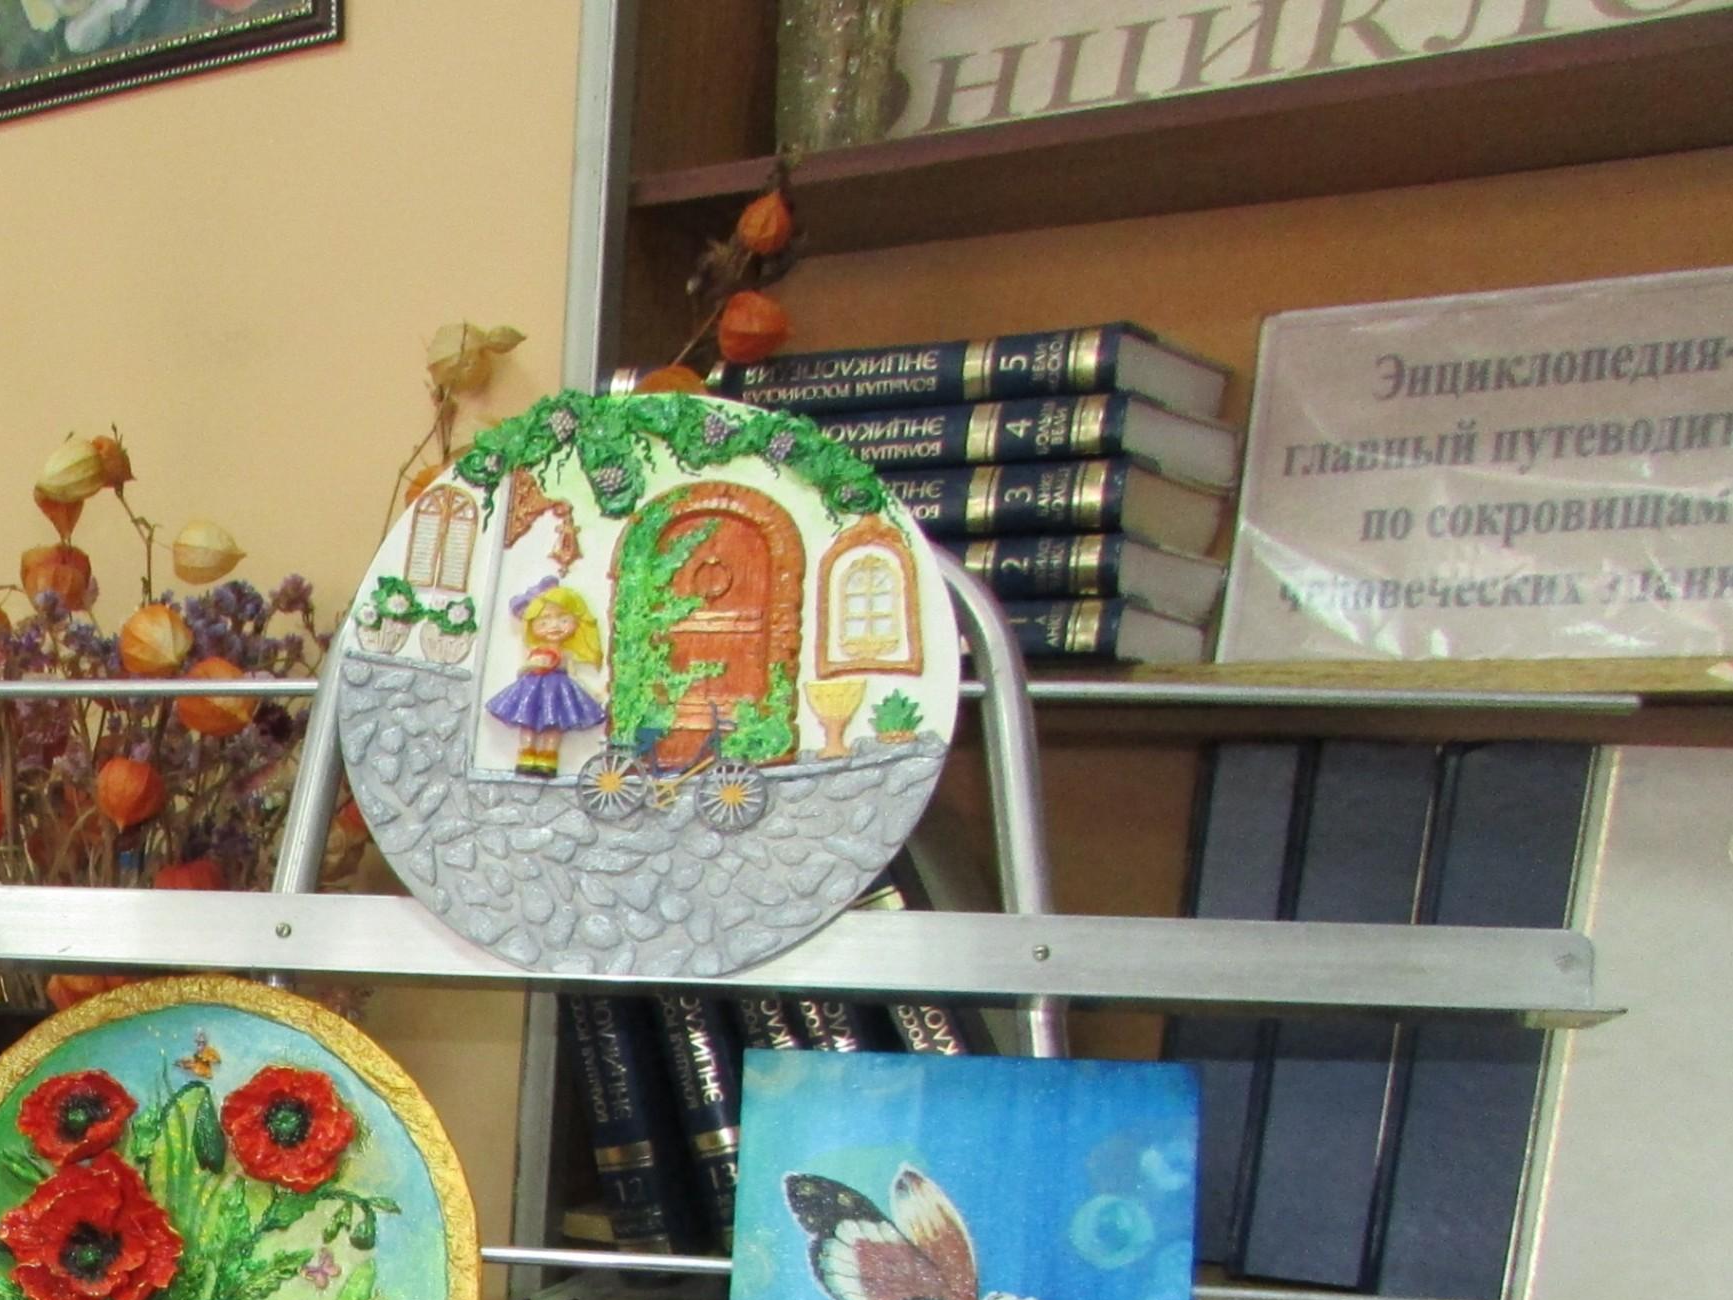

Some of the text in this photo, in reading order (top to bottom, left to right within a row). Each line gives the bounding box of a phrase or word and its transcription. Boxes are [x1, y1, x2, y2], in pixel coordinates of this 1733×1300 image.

[999, 353, 1028, 373] 5
[856, 376, 938, 397] БОЛЬШАЯ
[1004, 417, 1033, 439] 4
[859, 440, 943, 461] БОЛЬШАЯ
[1282, 419, 1479, 477] главный
[1004, 484, 1033, 503] 3
[1359, 490, 1731, 549] по сокровищам
[1000, 555, 1030, 575] 2
